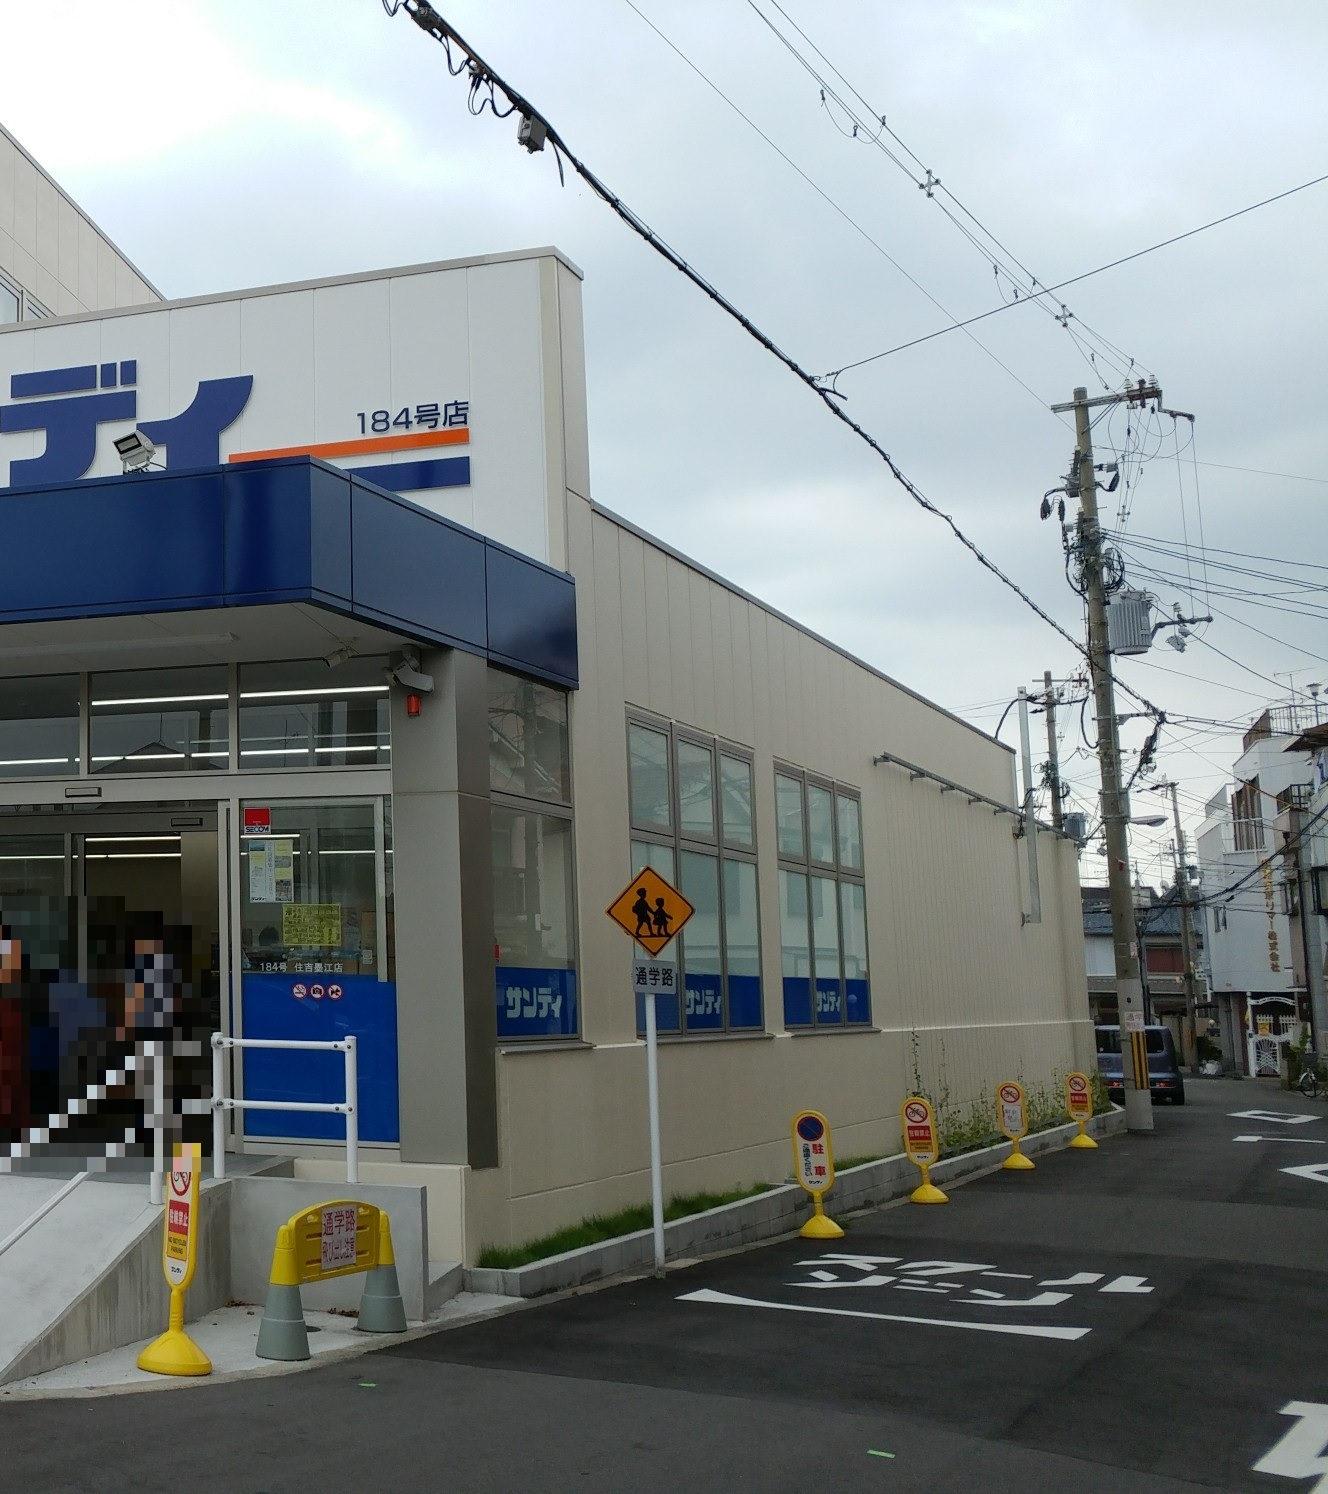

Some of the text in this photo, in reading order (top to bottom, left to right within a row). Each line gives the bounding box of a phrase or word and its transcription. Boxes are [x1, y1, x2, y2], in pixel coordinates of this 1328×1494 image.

[356, 400, 469, 434] 184号店
[245, 825, 269, 833] SECOM
[260, 962, 343, 973] 184号 住吉墨江店
[635, 966, 674, 987] 通学路
[323, 1208, 355, 1236] 通学路
